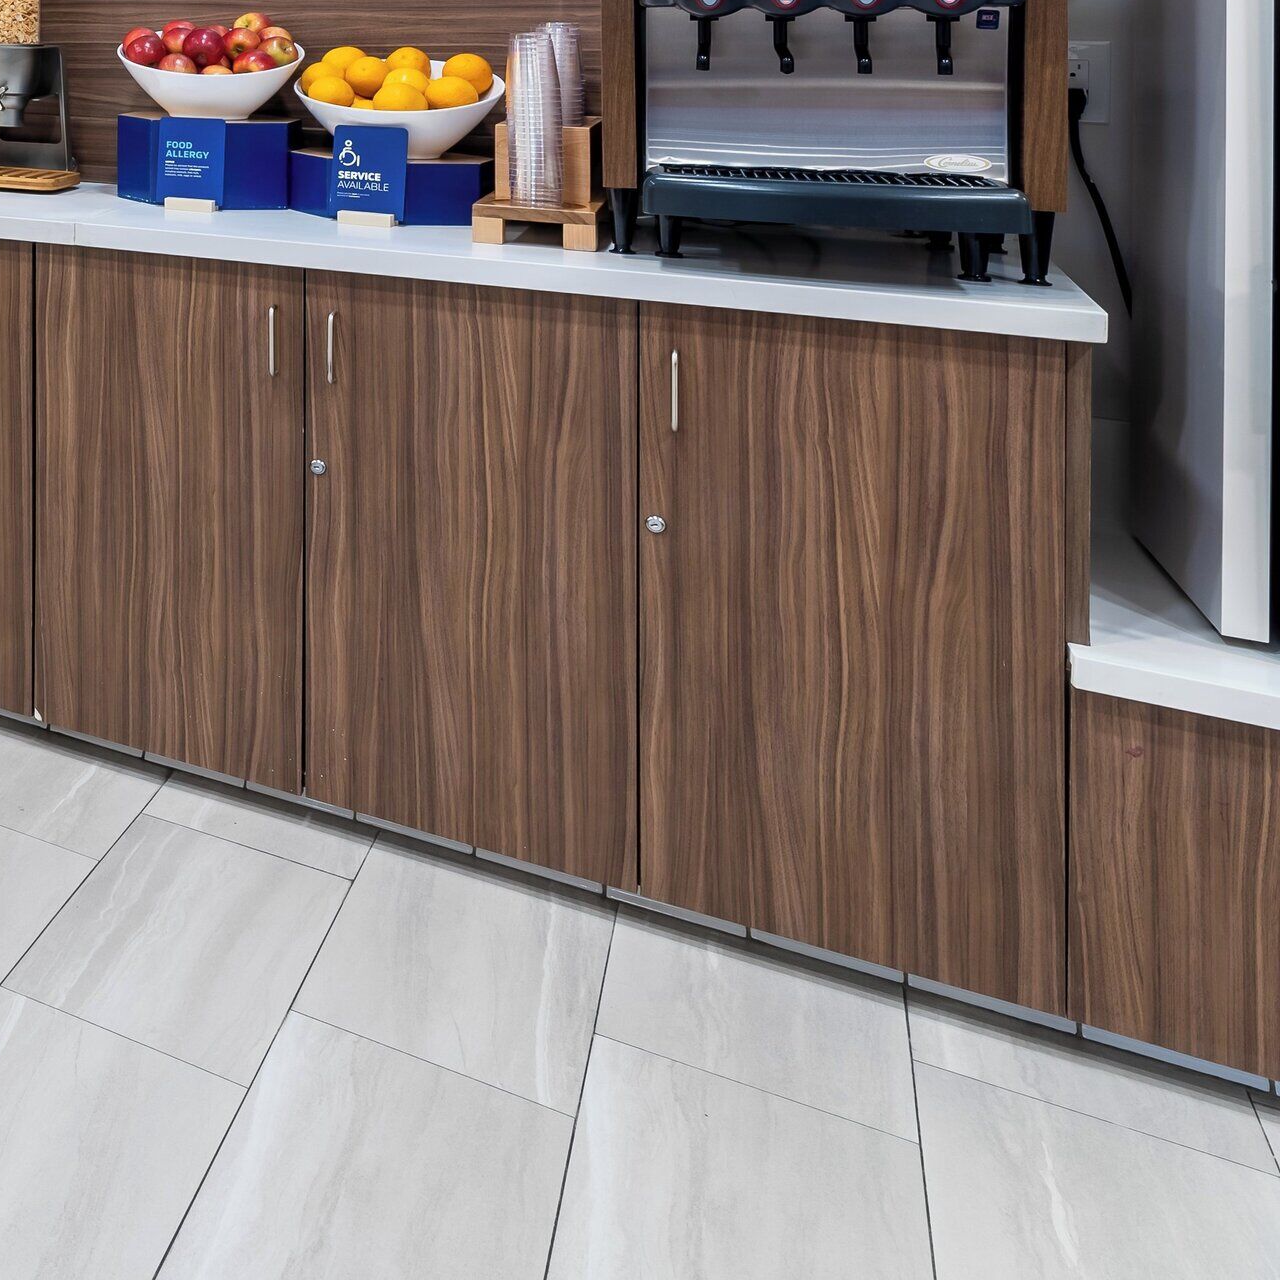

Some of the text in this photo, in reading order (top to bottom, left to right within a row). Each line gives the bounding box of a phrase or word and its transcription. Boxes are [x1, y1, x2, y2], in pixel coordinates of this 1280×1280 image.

[166, 140, 193, 149] FOOD
[165, 150, 210, 159] ALLERGY
[337, 170, 381, 181] SERVICE
[337, 180, 389, 192] AVAILABLE
